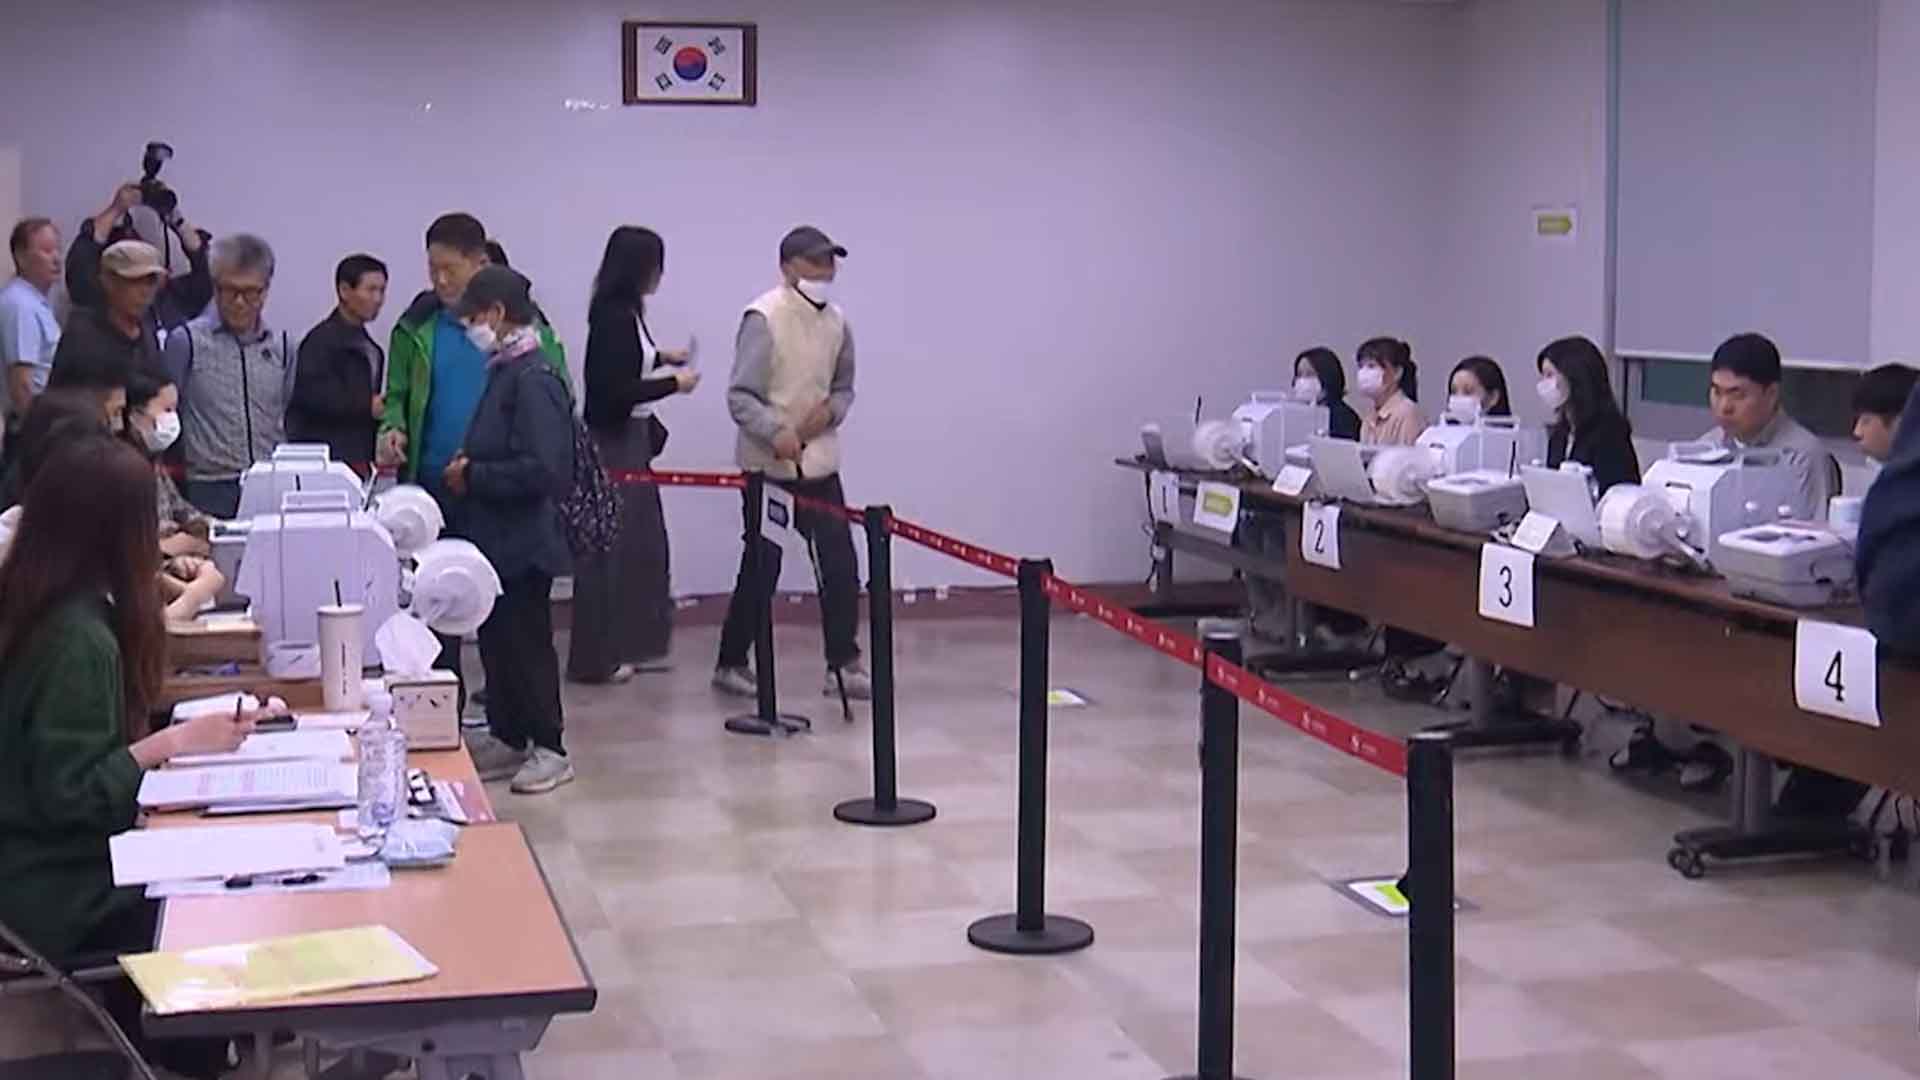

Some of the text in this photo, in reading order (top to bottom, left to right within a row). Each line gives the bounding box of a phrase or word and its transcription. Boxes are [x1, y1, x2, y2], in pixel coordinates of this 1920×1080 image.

[1314, 519, 1325, 554] 2
[1498, 565, 1513, 608] 3
[1824, 650, 1845, 703] 4
